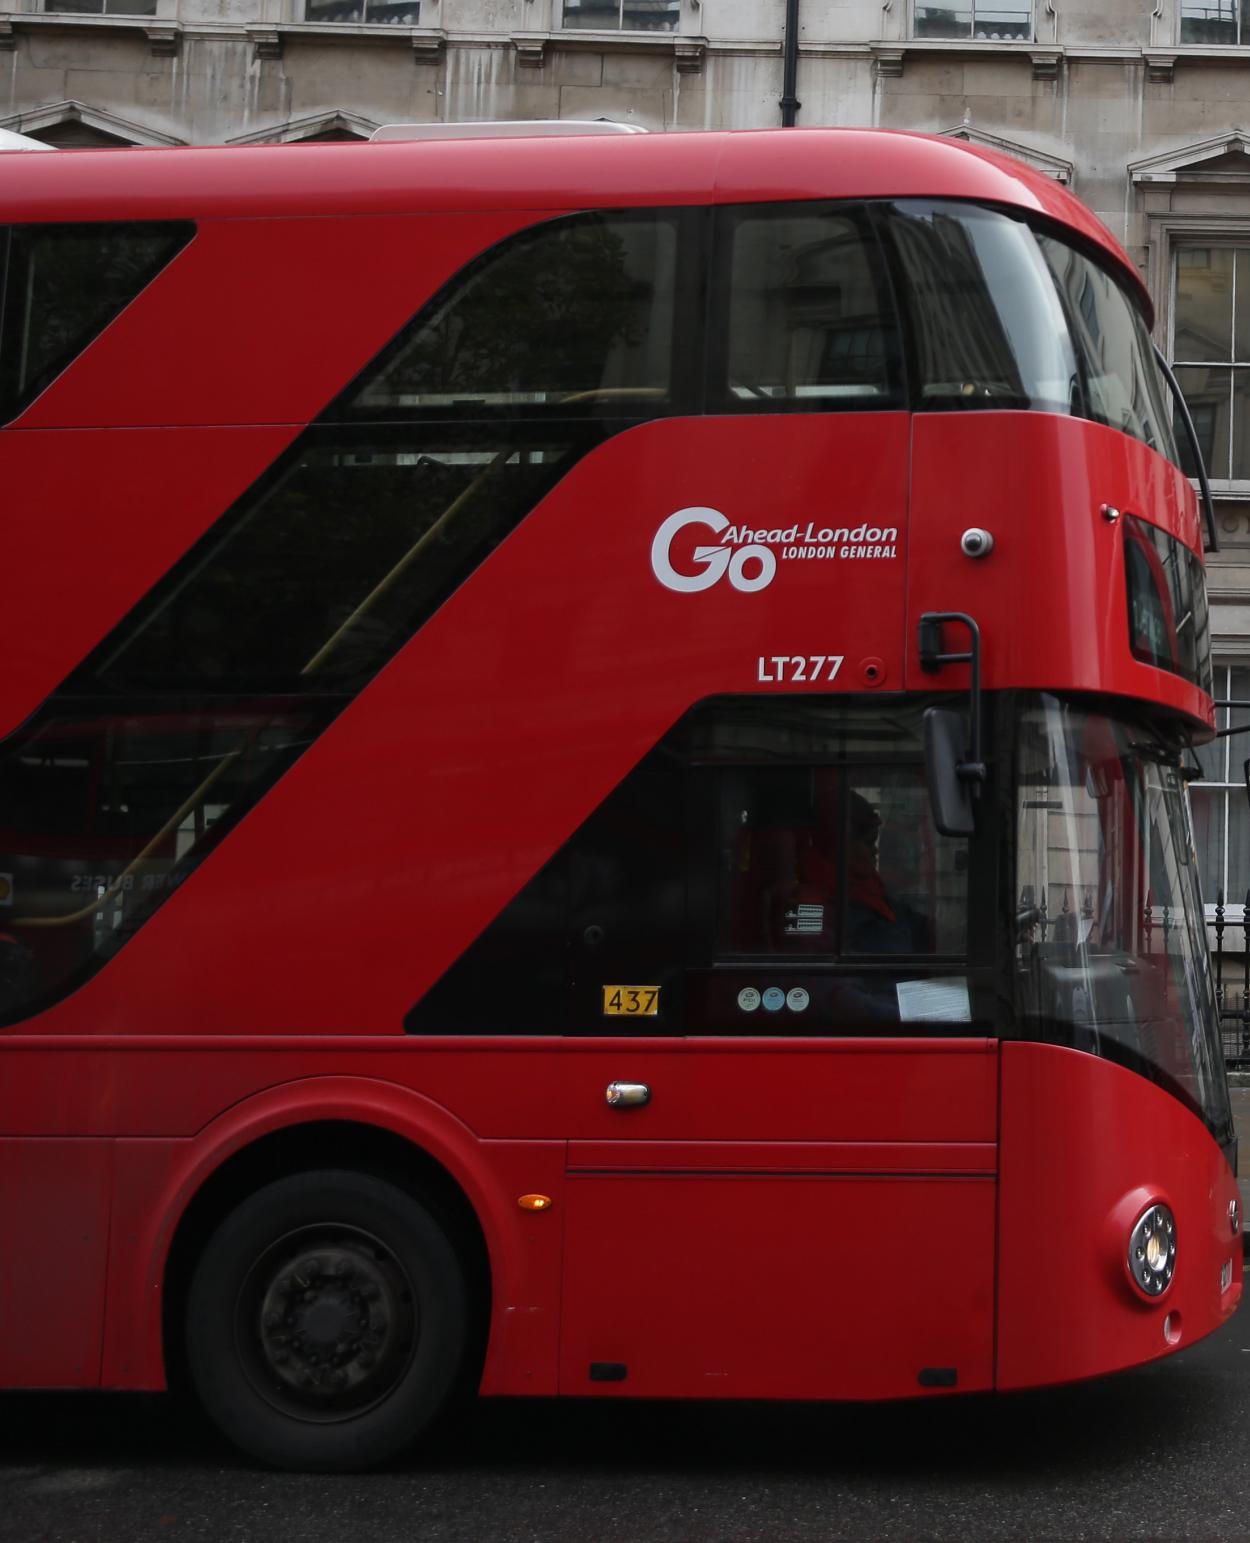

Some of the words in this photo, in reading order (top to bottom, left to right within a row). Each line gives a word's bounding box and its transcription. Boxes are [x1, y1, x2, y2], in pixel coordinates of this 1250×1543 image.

[651, 506, 777, 592] Go
[720, 522, 898, 543] Ahead-London
[782, 545, 835, 560] LONDON
[840, 545, 897, 559] GENERAL
[758, 656, 844, 682] LT277
[608, 990, 658, 1012] 437
